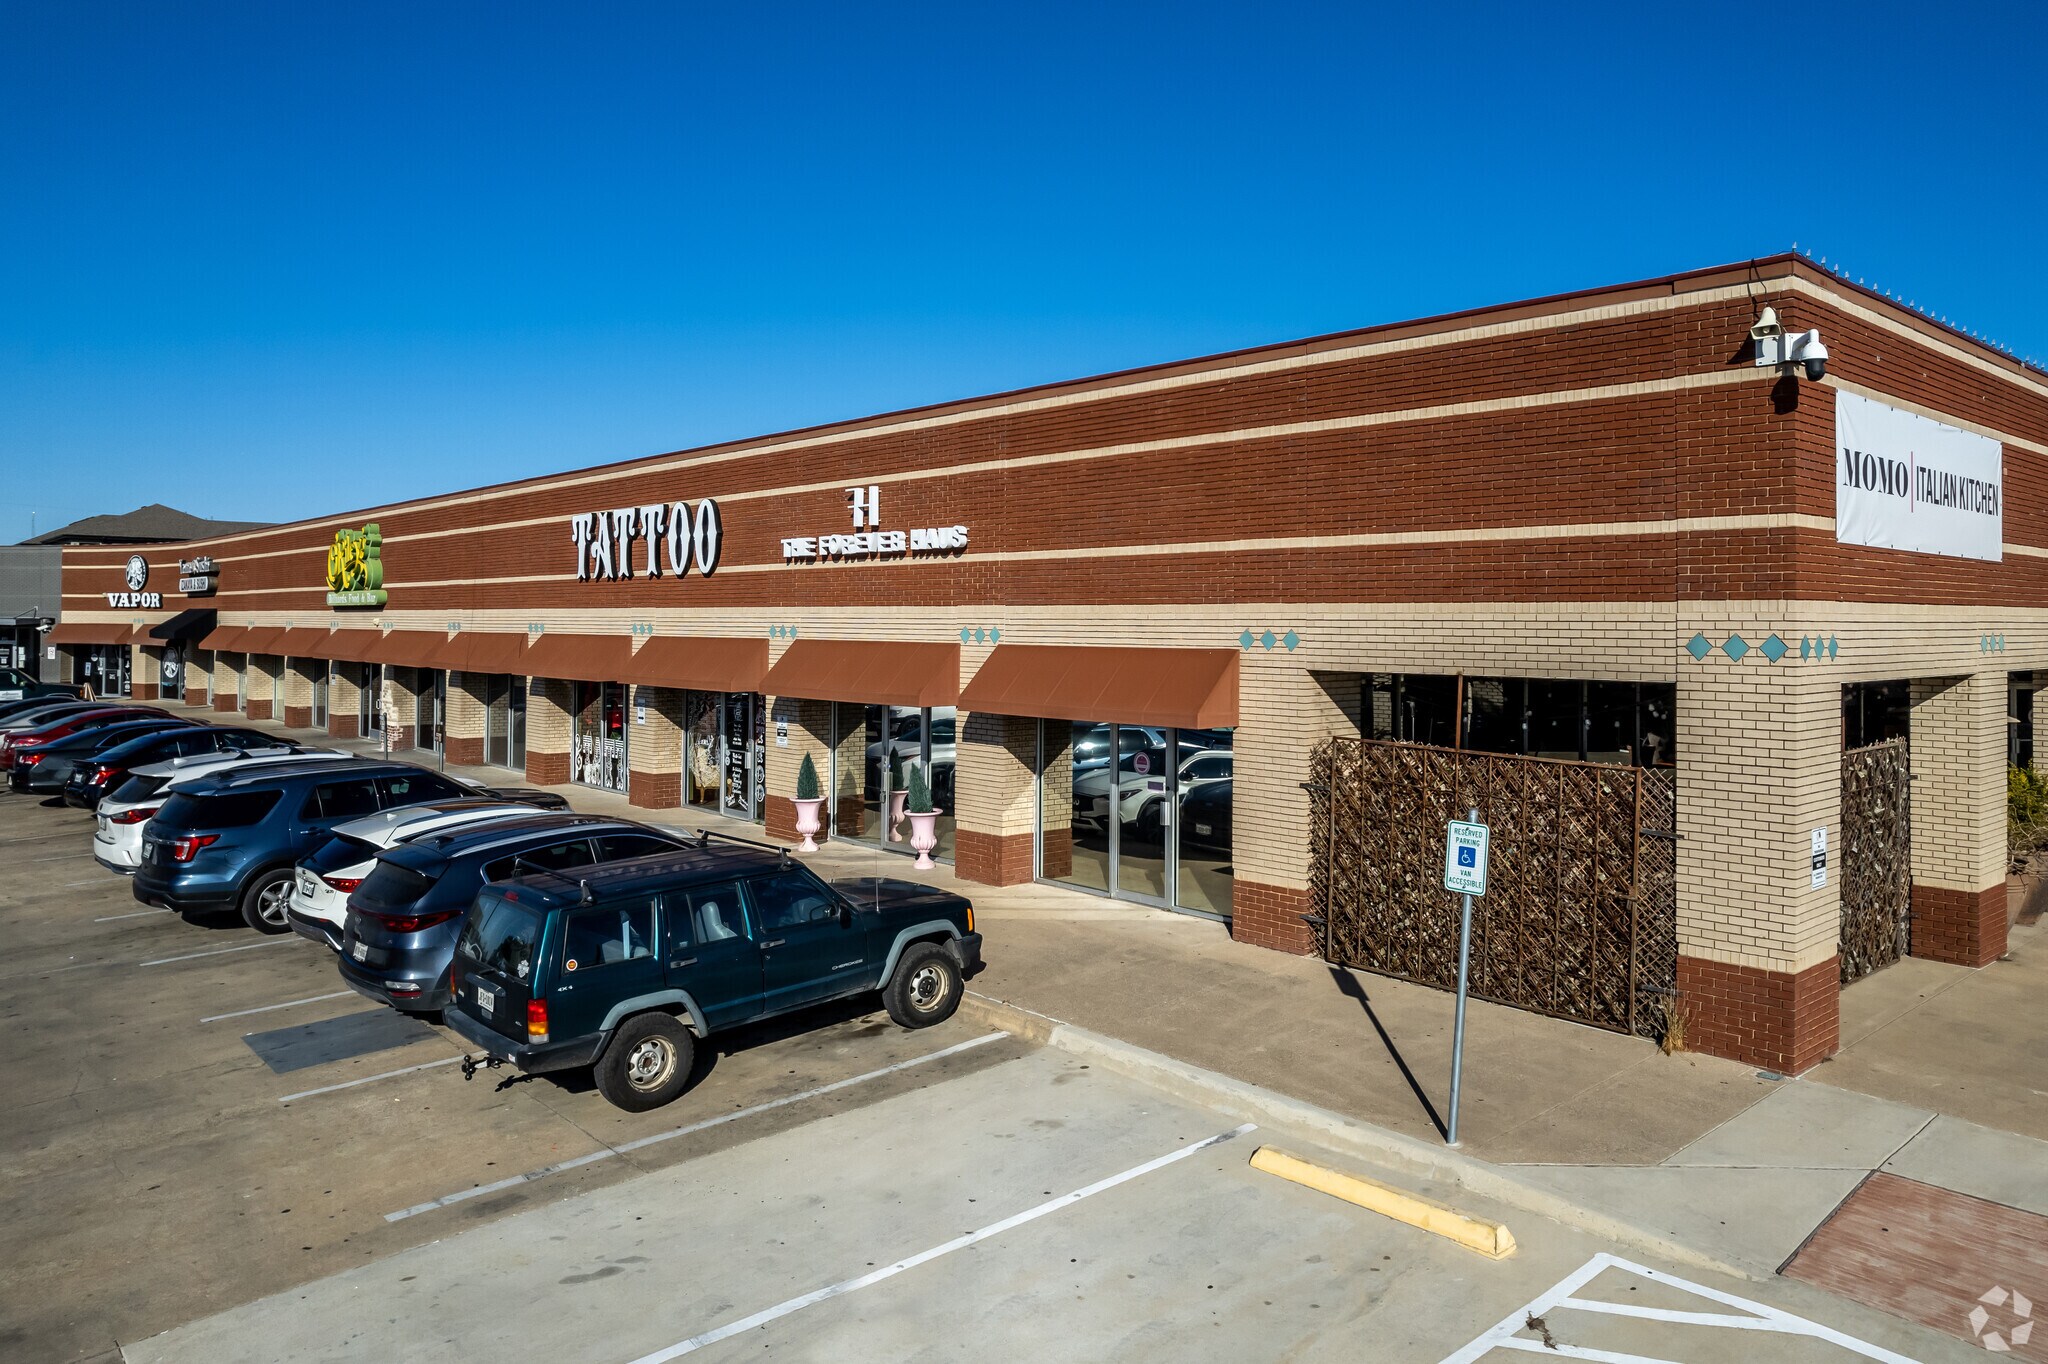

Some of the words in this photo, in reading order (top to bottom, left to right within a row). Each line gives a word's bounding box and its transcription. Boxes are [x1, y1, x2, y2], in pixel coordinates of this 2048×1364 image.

[1843, 447, 1909, 498] MOMO
[1916, 465, 1957, 508] ITALIAN
[1960, 475, 1999, 517] KITCHEN
[845, 485, 880, 528] H
[571, 498, 721, 581] TATTOO
[781, 537, 817, 558] THE
[819, 530, 907, 556] FOREVER
[910, 525, 968, 550] HAUS
[107, 592, 161, 608] VAPOR
[348, 593, 360, 603] Food
[366, 592, 376, 603] Bar
[1453, 827, 1483, 839] RESERVED
[1455, 836, 1481, 847] PARKING
[1460, 869, 1472, 878] VAN
[1448, 877, 1482, 889] ACCESSIBLE
[831, 958, 864, 970] CHEROKEE
